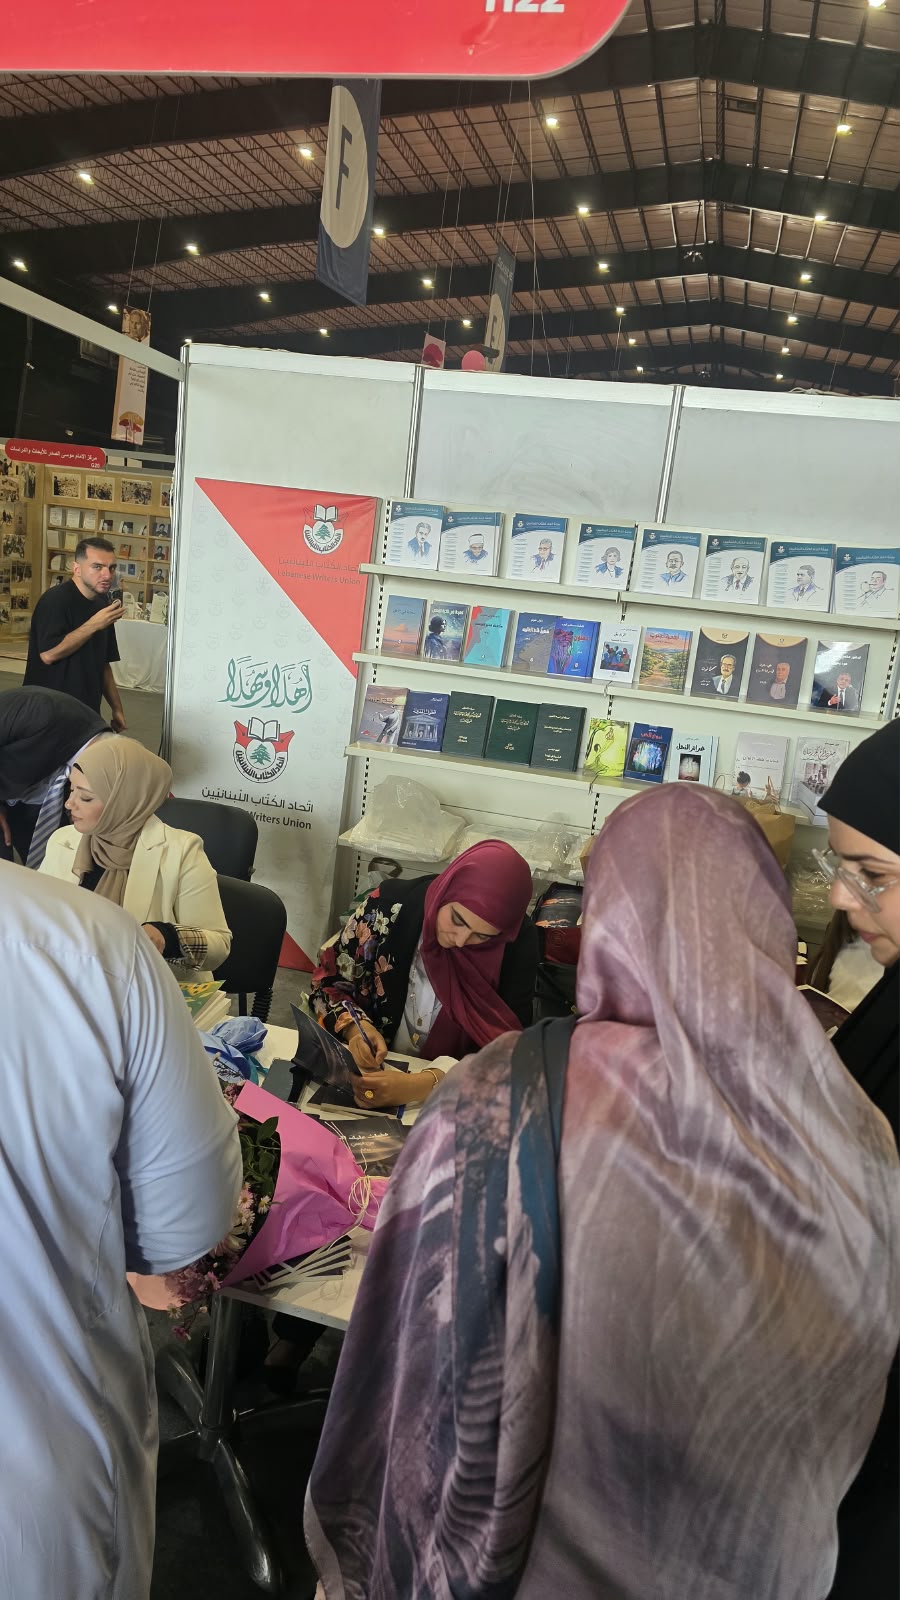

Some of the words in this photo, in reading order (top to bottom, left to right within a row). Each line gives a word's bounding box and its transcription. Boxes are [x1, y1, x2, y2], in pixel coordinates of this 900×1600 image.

[335, 124, 352, 210] F
[277, 569, 311, 580] Lebanese
[312, 573, 338, 583] Writers
[339, 575, 361, 585] Union
[282, 816, 312, 830] Union
